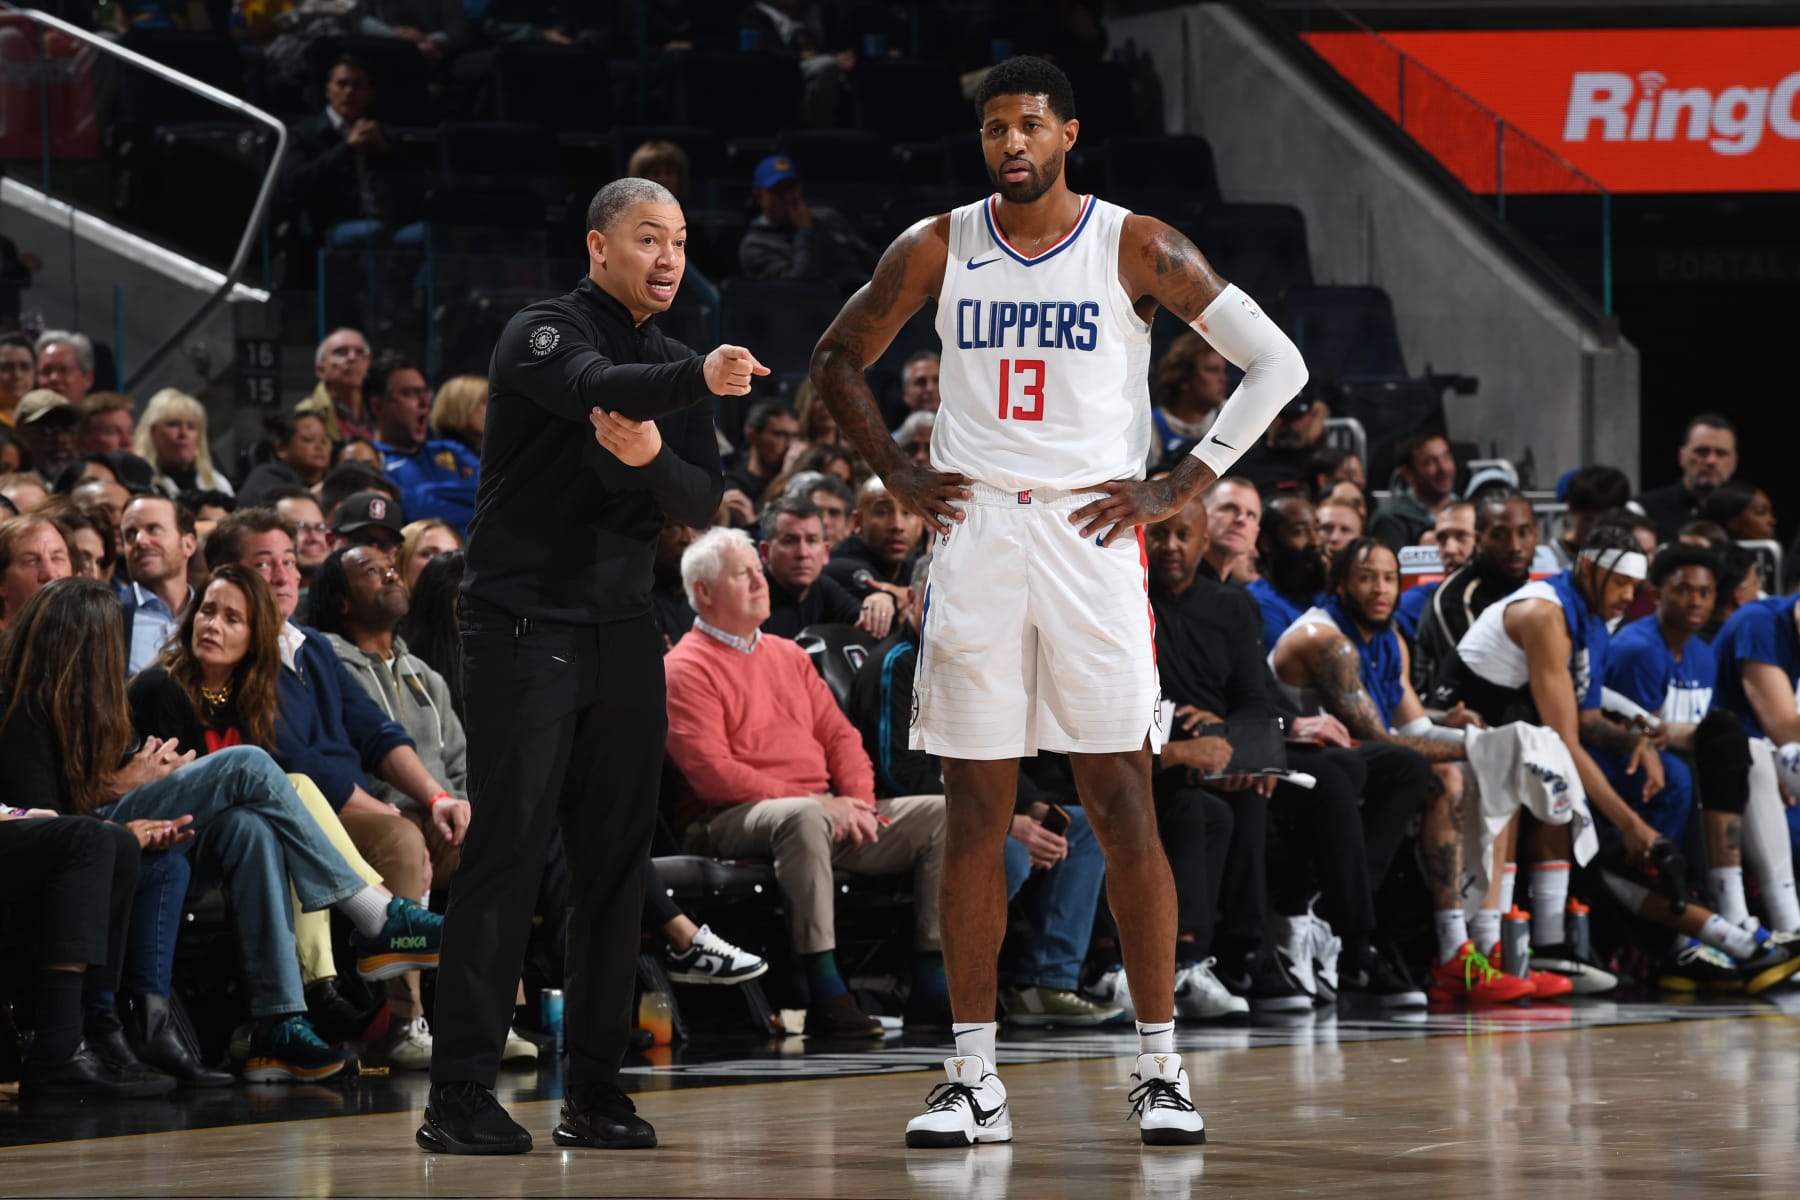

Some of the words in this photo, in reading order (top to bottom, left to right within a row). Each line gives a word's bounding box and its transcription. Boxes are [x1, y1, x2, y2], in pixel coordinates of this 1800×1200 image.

[957, 298, 1100, 351] CLIPPERS
[246, 341, 273, 367] 16
[246, 377, 274, 403] 15
[998, 358, 1046, 421] 13
[391, 936, 427, 949] HOKA
